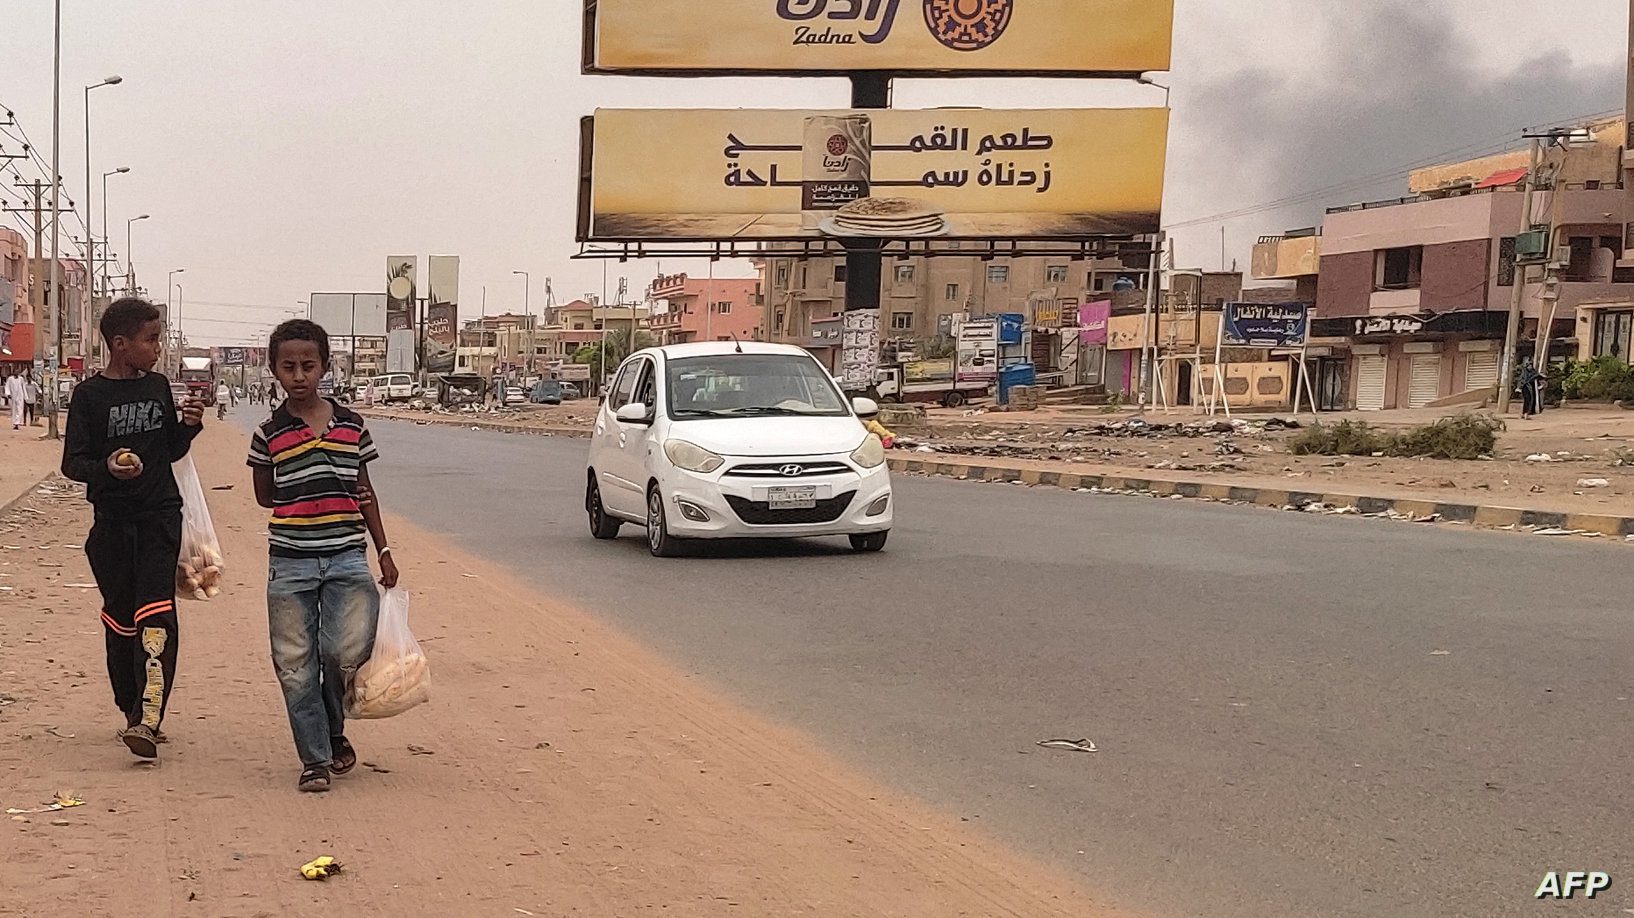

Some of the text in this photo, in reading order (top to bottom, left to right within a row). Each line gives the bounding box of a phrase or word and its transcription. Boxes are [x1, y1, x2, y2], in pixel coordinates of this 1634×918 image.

[792, 26, 857, 45] Zadna
[975, 127, 1053, 155] طعم
[1267, 306, 1302, 323] صيدلية
[107, 400, 163, 438] NIKE
